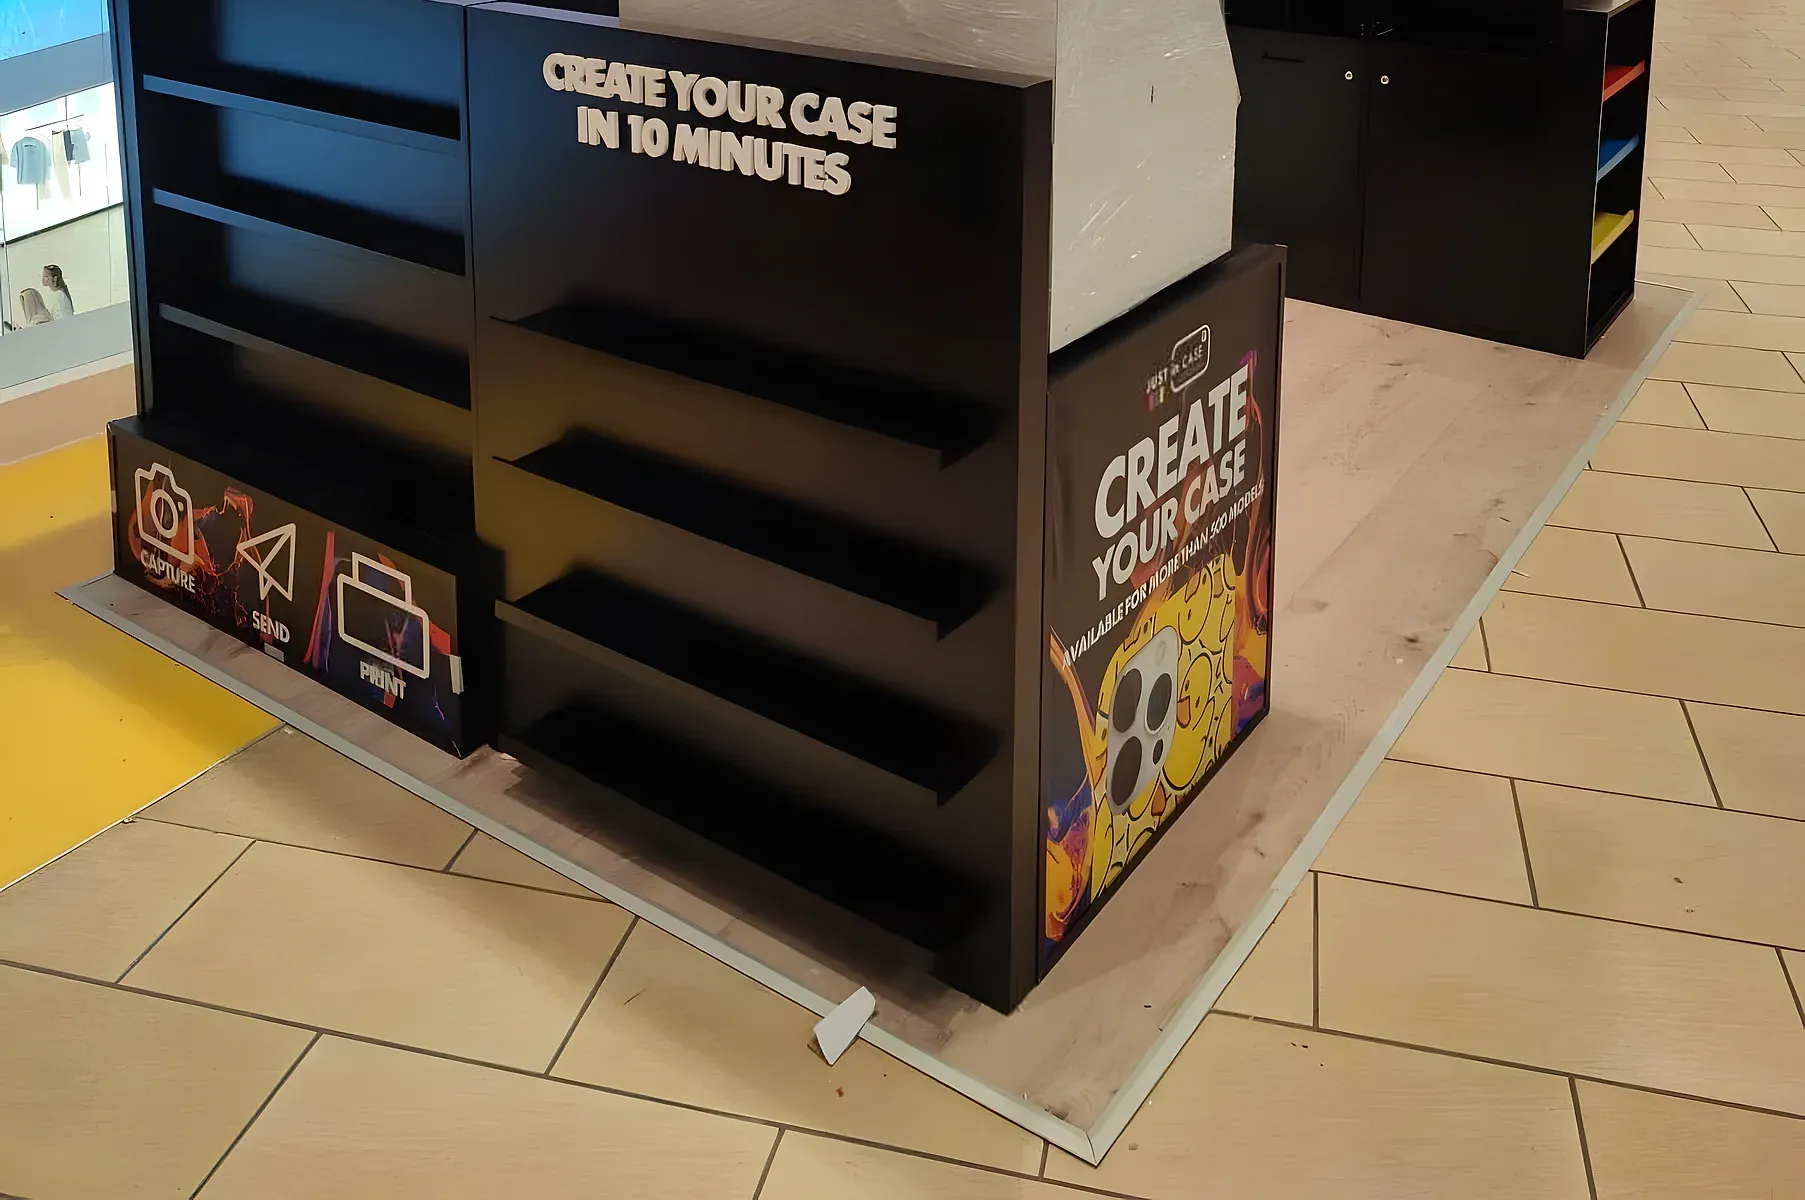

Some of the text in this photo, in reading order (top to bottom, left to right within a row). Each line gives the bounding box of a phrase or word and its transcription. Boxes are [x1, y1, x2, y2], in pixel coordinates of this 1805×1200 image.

[542, 52, 898, 149] CREATE YOUR CASE
[577, 106, 852, 196] IN 10 MINUTES
[1146, 367, 1168, 394] JUST
[1182, 345, 1203, 368] CASE
[1094, 364, 1248, 538] CREATE
[1092, 438, 1246, 602] YOUR CASE
[140, 548, 196, 593] CAPTURE
[1062, 602, 1124, 671] AVAILABLE
[1125, 583, 1147, 615] FOR
[1148, 555, 1180, 595] MORE
[1180, 527, 1208, 565] THAN
[252, 610, 290, 643] SEND
[359, 660, 406, 700] PRINT
